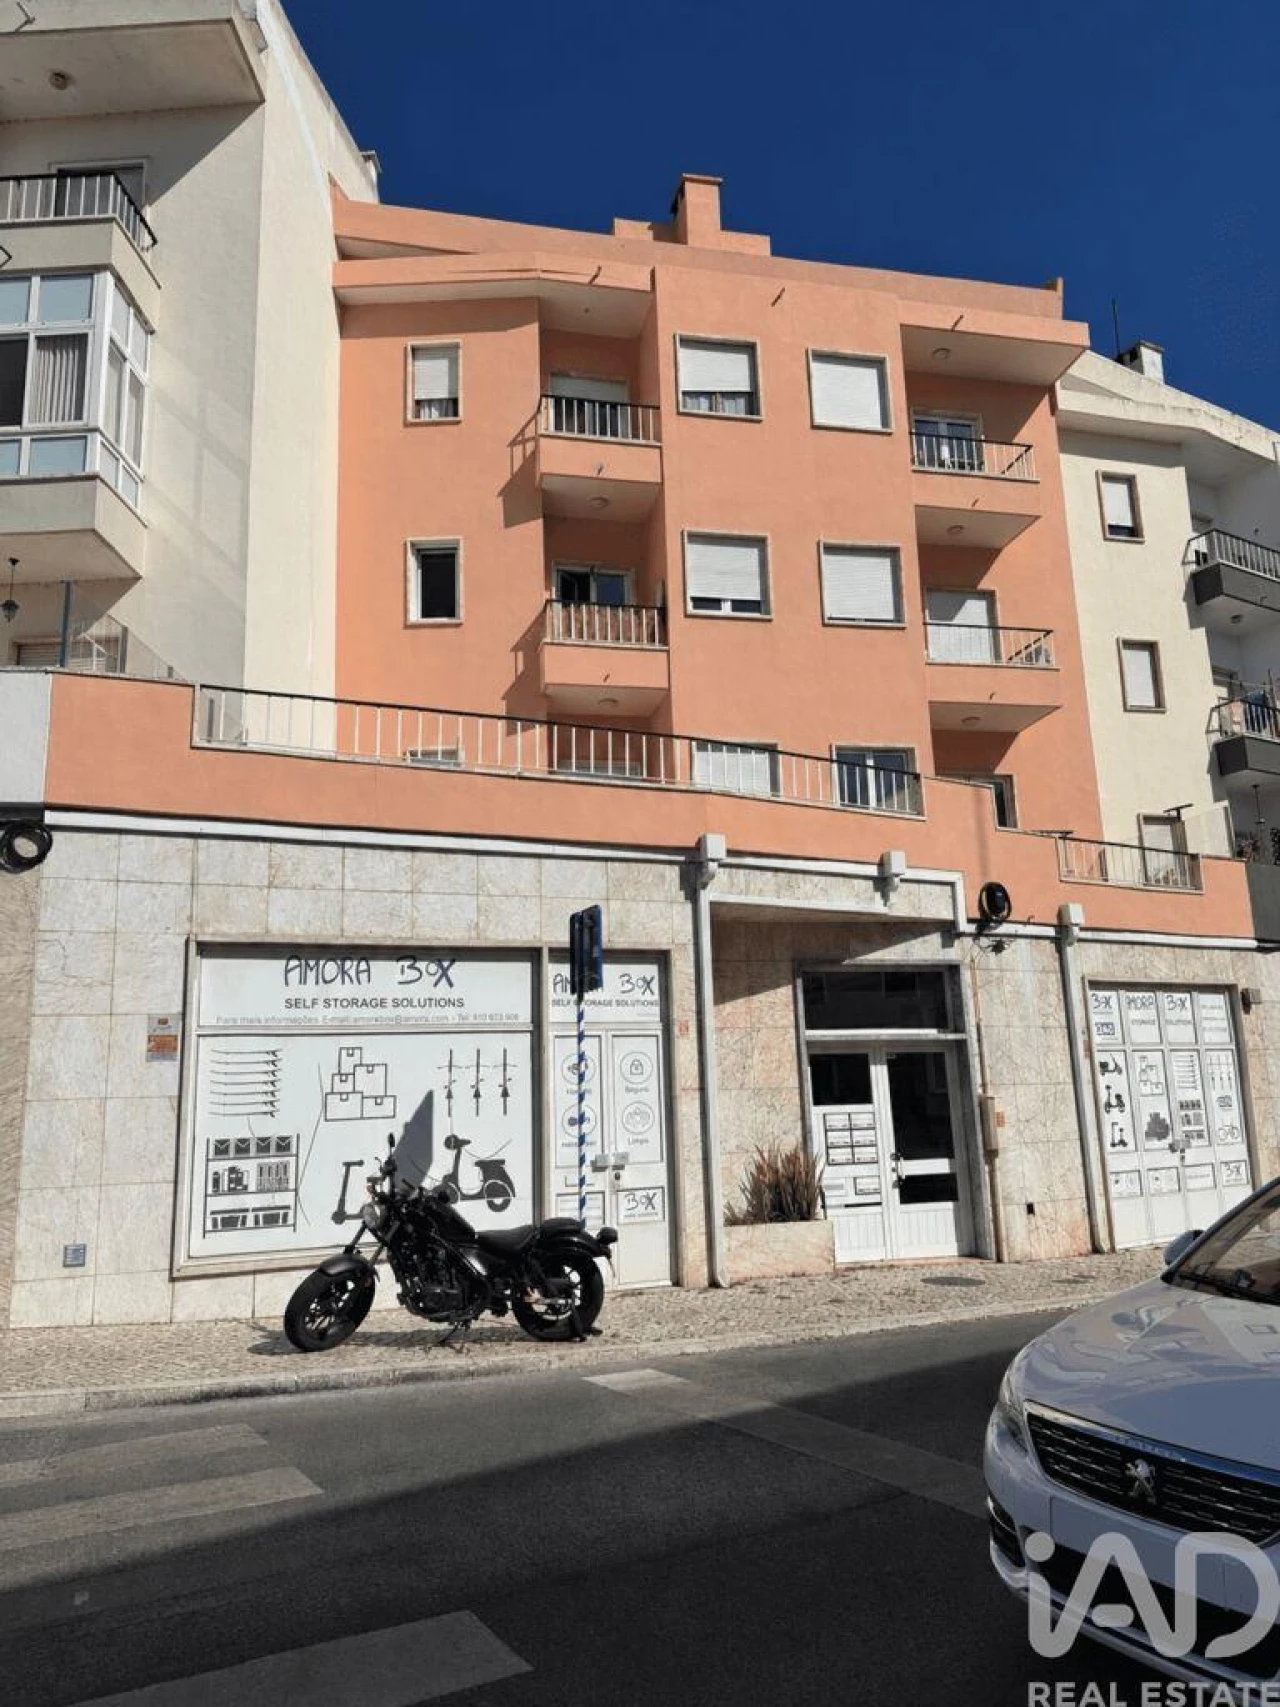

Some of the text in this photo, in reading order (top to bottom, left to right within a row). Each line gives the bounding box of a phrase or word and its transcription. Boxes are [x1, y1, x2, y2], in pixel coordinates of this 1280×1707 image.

[284, 955, 456, 988] AMORA BOX
[284, 997, 465, 1009] SELF STORAGE SOLUTIONS
